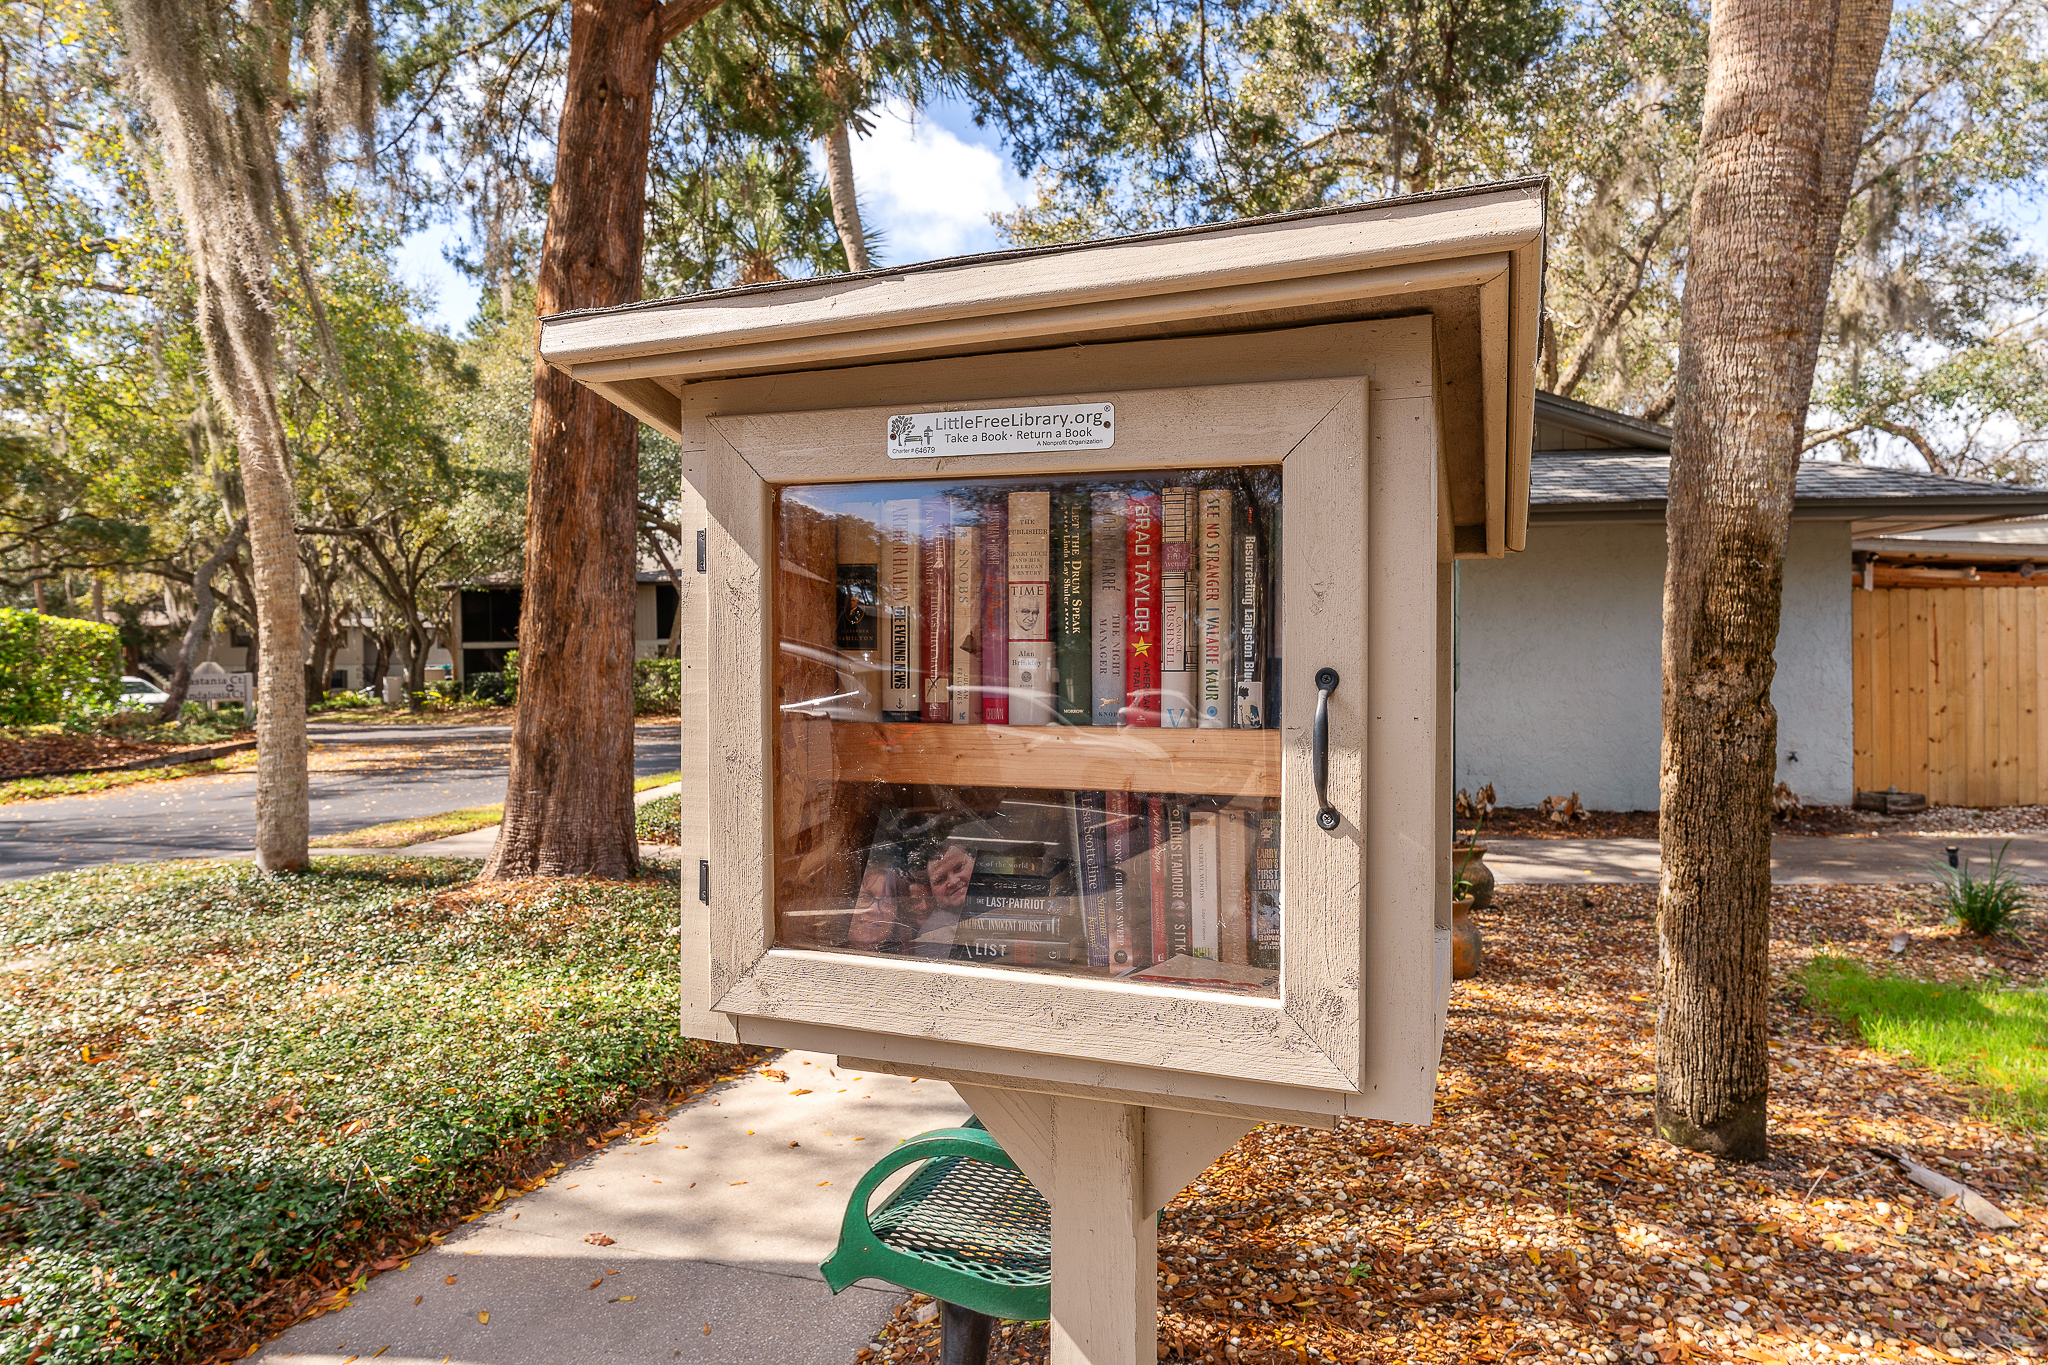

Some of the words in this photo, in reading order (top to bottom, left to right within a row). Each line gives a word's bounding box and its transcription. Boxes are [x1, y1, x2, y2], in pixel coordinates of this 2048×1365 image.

[935, 412, 1103, 431] LittleFreeLibrary.org
[945, 433, 968, 443] Take
[981, 431, 1007, 442] Book
[1017, 429, 1051, 440] Return
[1065, 427, 1092, 437] Book
[1206, 499, 1220, 518] SEE
[892, 505, 909, 554] ARTHUR
[1102, 511, 1116, 541] JOHN
[1134, 505, 1150, 556] BRAD
[1206, 523, 1220, 539] NO
[935, 524, 944, 568] CHARLE
[1063, 535, 1071, 559] Linda
[892, 558, 909, 603] HAILEY
[958, 549, 969, 603] SNOBS
[1062, 560, 1071, 576] Lay
[1071, 560, 1082, 594] DRUM
[1206, 544, 1220, 601] STRANGER
[1242, 536, 1255, 605] Resurrecting
[1011, 586, 1044, 596] TIME
[1063, 578, 1071, 605] Shuler
[1134, 561, 1150, 633] TAYLOR
[893, 606, 907, 622] THE
[1071, 599, 1083, 634] SPEAK
[1112, 614, 1120, 636] THE
[893, 625, 907, 661] EVENING
[1099, 618, 1108, 675] MANAGER
[1166, 605, 1177, 665] BUSHNELL
[1206, 617, 1220, 664] VALARIE
[1242, 608, 1255, 658] Langston
[1112, 642, 1120, 677] NIGHT
[189, 676, 227, 686] astania
[893, 664, 907, 689] NEWS
[1133, 666, 1141, 708] TRAITOR
[1143, 661, 1151, 712] AMERICAN
[1205, 669, 1219, 700] KAUR
[185, 691, 230, 700] ndalusia
[986, 708, 1004, 720] CROWN
[1081, 798, 1093, 823] Lisa
[1170, 820, 1182, 850] LOUIS
[1083, 826, 1099, 890] Scottoline
[1114, 839, 1122, 864] SONG
[1256, 848, 1278, 858] LARRY
[1257, 869, 1279, 880] FIRST
[1257, 880, 1279, 890] TEAM
[986, 897, 1006, 908] LAST
[1009, 897, 1045, 910] PATRIOT
[1115, 872, 1124, 913] CHIMNEY
[988, 919, 1016, 931] INNOCENT
[1018, 920, 1043, 932] TOURIST
[1088, 916, 1097, 947] Knows
[1097, 896, 1108, 938] Someone
[1116, 915, 1125, 946] SWEEP
[975, 943, 1007, 957] LIST
[1174, 923, 1186, 955] SITK
